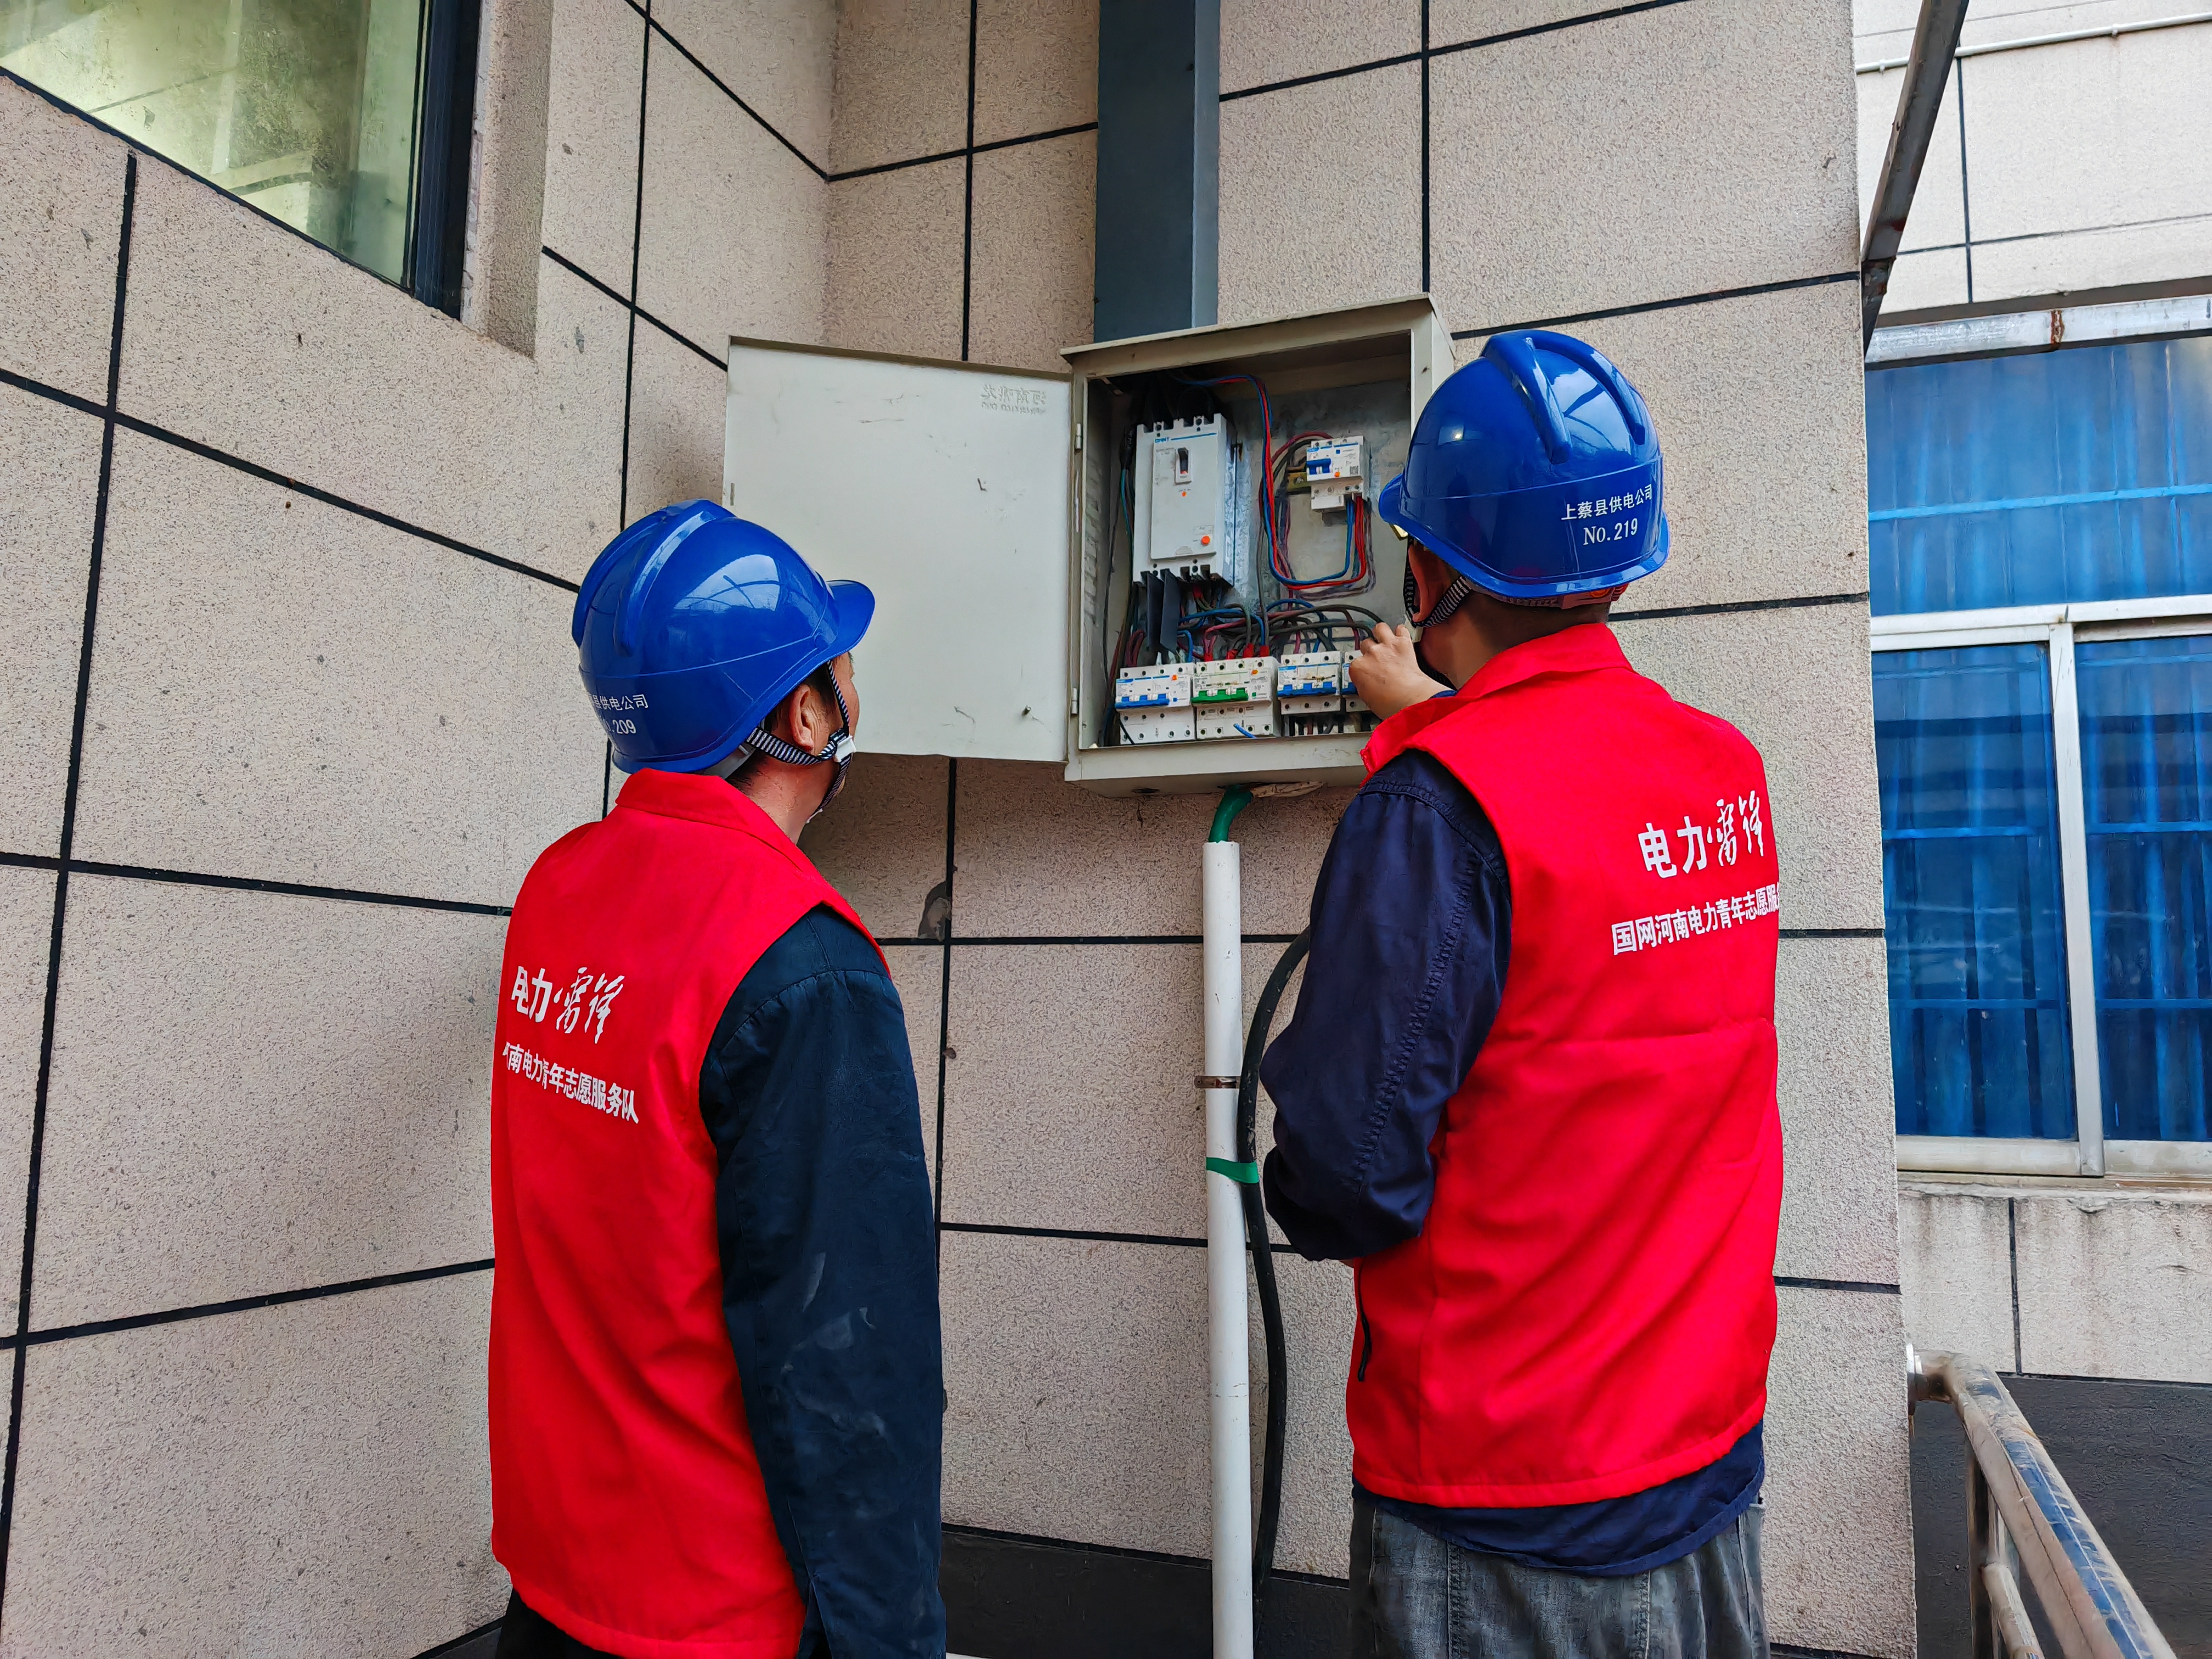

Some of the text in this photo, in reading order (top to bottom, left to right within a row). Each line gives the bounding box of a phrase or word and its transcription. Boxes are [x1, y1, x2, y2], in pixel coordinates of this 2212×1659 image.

[1561, 484, 1652, 521] 上蔡县供电公司
[1583, 518, 1638, 545] No.219
[589, 694, 648, 710] 县供电公司
